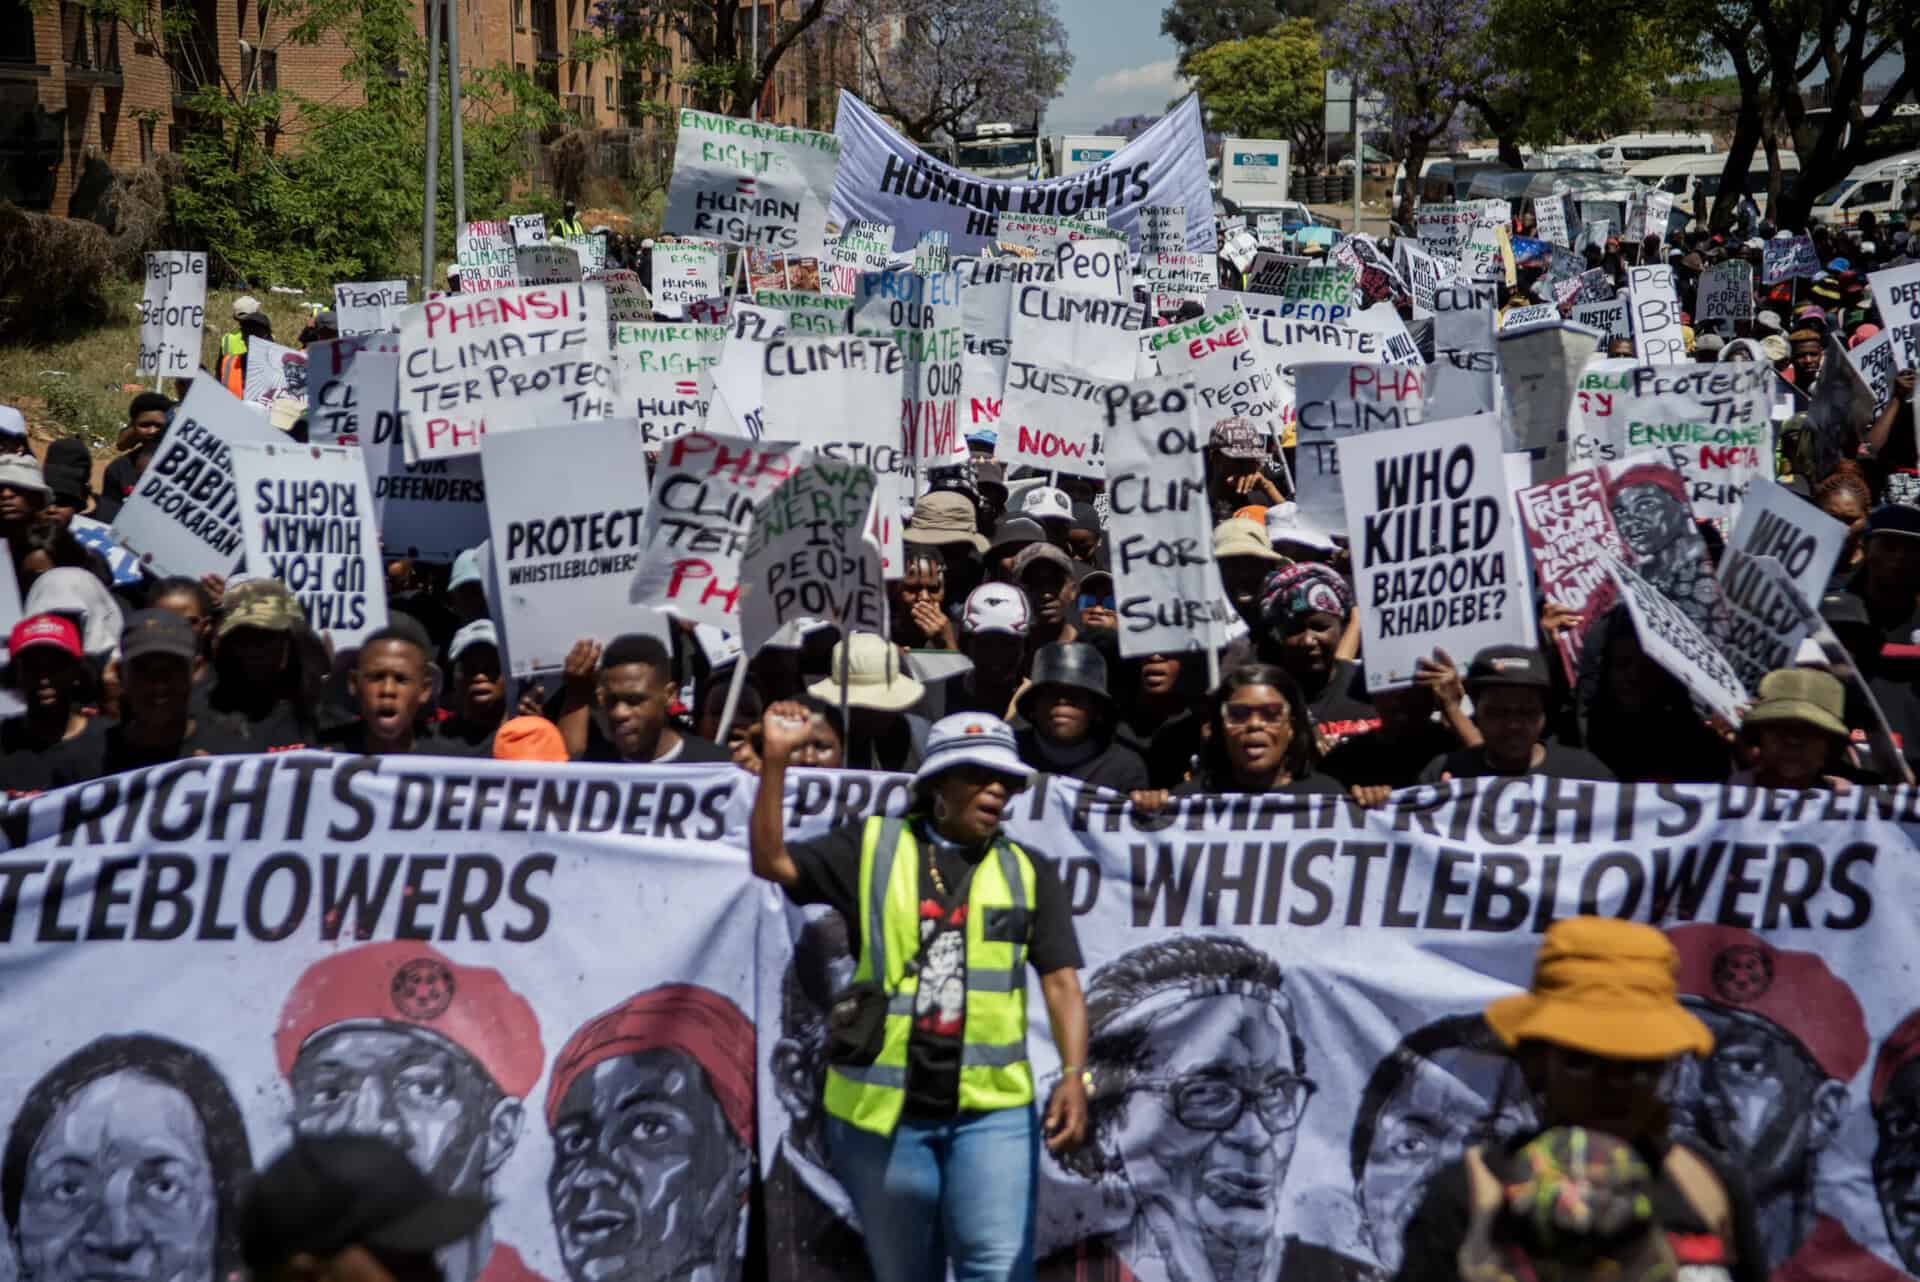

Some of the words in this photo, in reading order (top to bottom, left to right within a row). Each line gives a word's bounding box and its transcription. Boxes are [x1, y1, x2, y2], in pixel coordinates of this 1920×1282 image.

[703, 142, 786, 172] RIGHTS
[880, 155, 1007, 217] HUMAN
[1020, 162, 1150, 217] RIGHTS
[696, 190, 799, 222] HUMAN
[1140, 205, 1184, 216] PROTECT
[470, 239, 493, 251] OUR
[694, 212, 797, 247] RIGHTS
[855, 231, 875, 241] OUR
[460, 250, 515, 266] CLIMATE
[460, 269, 482, 281] FOR
[488, 267, 511, 279] OUR
[866, 254, 888, 268] OUR
[1413, 256, 1431, 274] WHO
[662, 279, 707, 289] HUMAN
[864, 271, 961, 305] PROTECT
[1706, 290, 1749, 303] PEOPLE
[140, 298, 203, 328] Before
[890, 301, 934, 331] OUR
[1019, 286, 1146, 331] CLIMATE
[1579, 307, 1623, 326] JUSTICE
[1638, 299, 1680, 333] BE
[1707, 303, 1750, 317] POWER
[406, 327, 588, 379] CLIMATE
[763, 339, 904, 377] CLIMATE
[410, 379, 482, 413] TER
[927, 361, 962, 397] OUR
[562, 391, 614, 421] THE
[1701, 398, 1755, 425] THE
[375, 474, 485, 502] DEFENDERS
[1376, 444, 1475, 512] WHO
[254, 479, 358, 518] RIGHTS
[140, 476, 245, 557] DEOKARAN
[506, 506, 643, 561] PROTECT
[1363, 496, 1500, 569] KILLED
[261, 519, 361, 555] HUMAN
[1745, 508, 1818, 580] WHO
[1121, 534, 1210, 575] FOR
[331, 558, 366, 593] UP
[1372, 551, 1505, 607] BAZOOKA
[1379, 589, 1507, 640] RHADEBE?
[56, 755, 383, 847] RIGHTS
[384, 772, 737, 838] DEFENDERS
[1392, 776, 1704, 844] RIGHTS
[1130, 840, 1878, 932] WHISTLEBLOWERS
